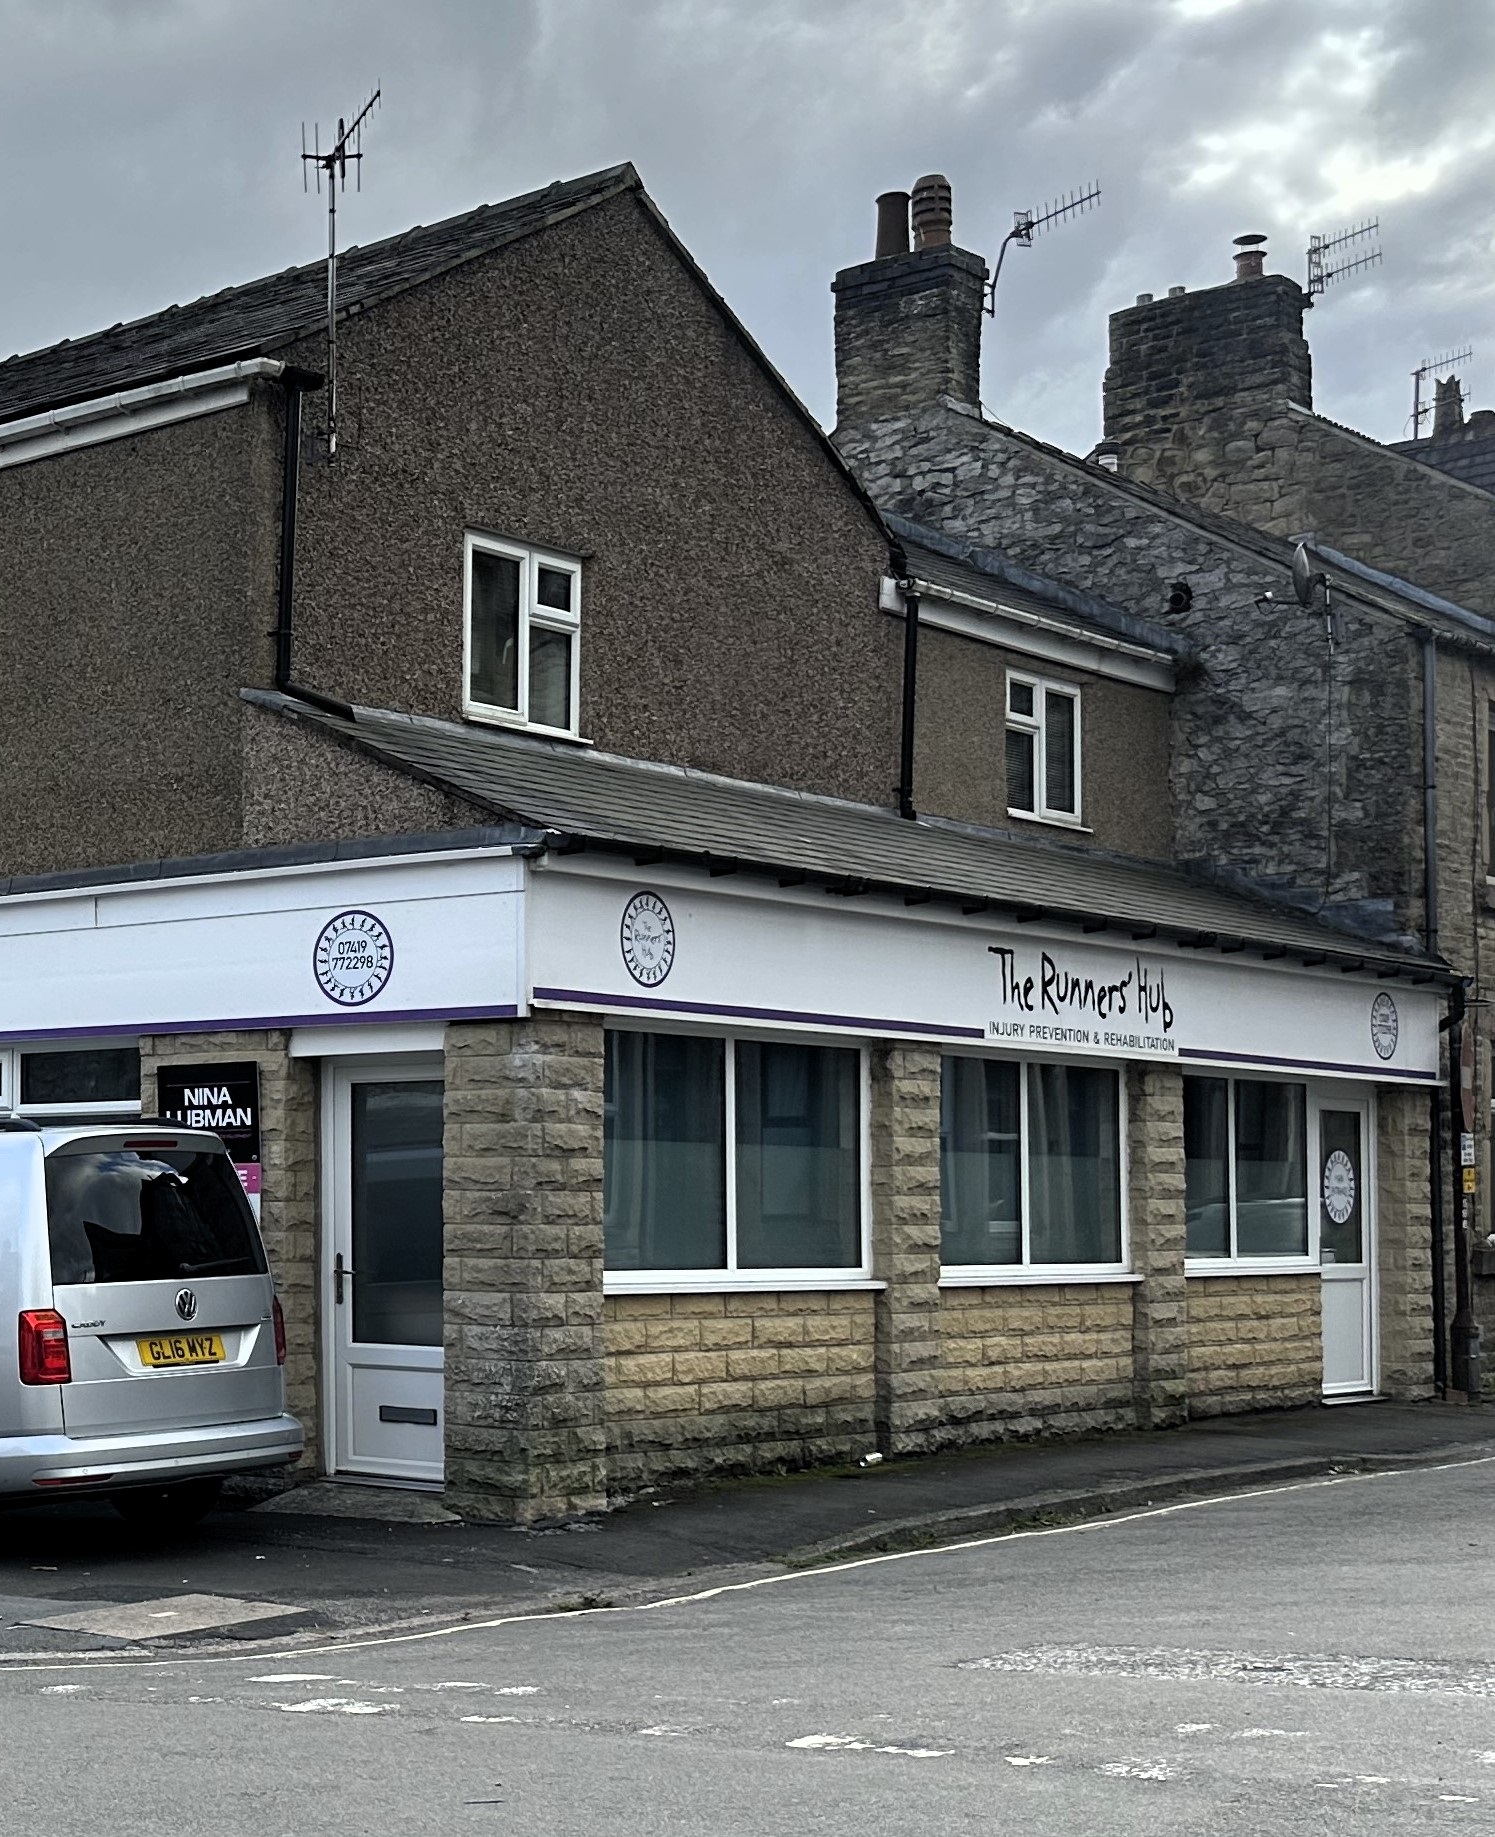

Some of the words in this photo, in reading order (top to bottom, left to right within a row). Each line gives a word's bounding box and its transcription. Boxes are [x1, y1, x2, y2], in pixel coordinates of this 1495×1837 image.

[338, 940, 367, 955] 07419
[332, 955, 373, 971] 772298
[988, 946, 1034, 1011] The
[1136, 956, 1174, 1033] Hub
[989, 1021, 1025, 1038] INJURY
[1029, 1025, 1089, 1043] PREVENTION
[1093, 1032, 1100, 1045] &
[1104, 1032, 1175, 1051] REHABILITATION
[184, 1087, 232, 1106] NINA
[149, 1339, 185, 1361] GL16
[188, 1337, 217, 1358] MYZ
